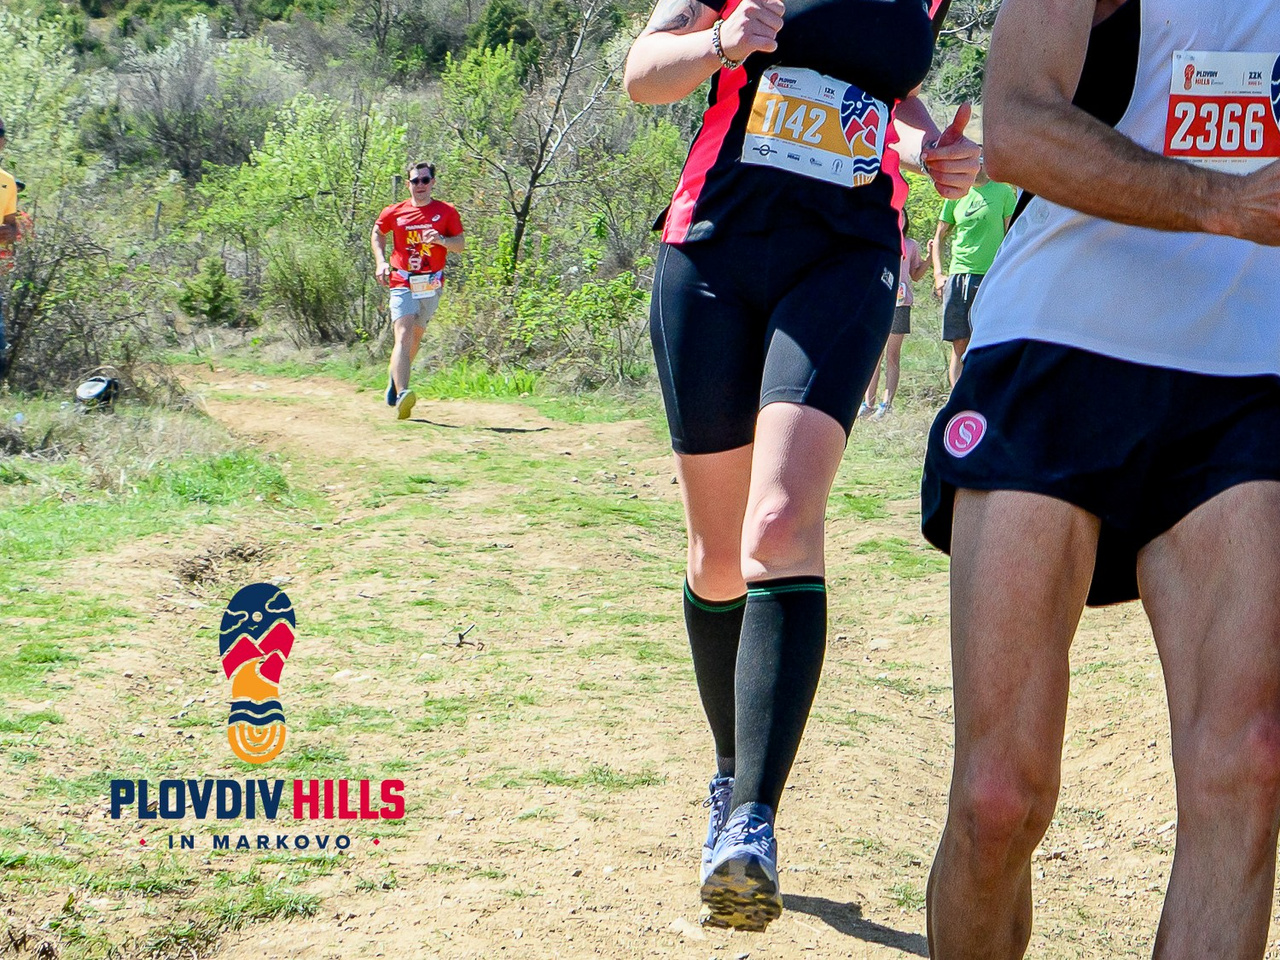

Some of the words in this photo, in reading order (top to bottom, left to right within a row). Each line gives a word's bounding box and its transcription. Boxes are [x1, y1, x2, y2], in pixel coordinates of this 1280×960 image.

[1248, 71, 1263, 80] 22K
[761, 99, 827, 144] 1142
[1169, 101, 1266, 151] 2366
